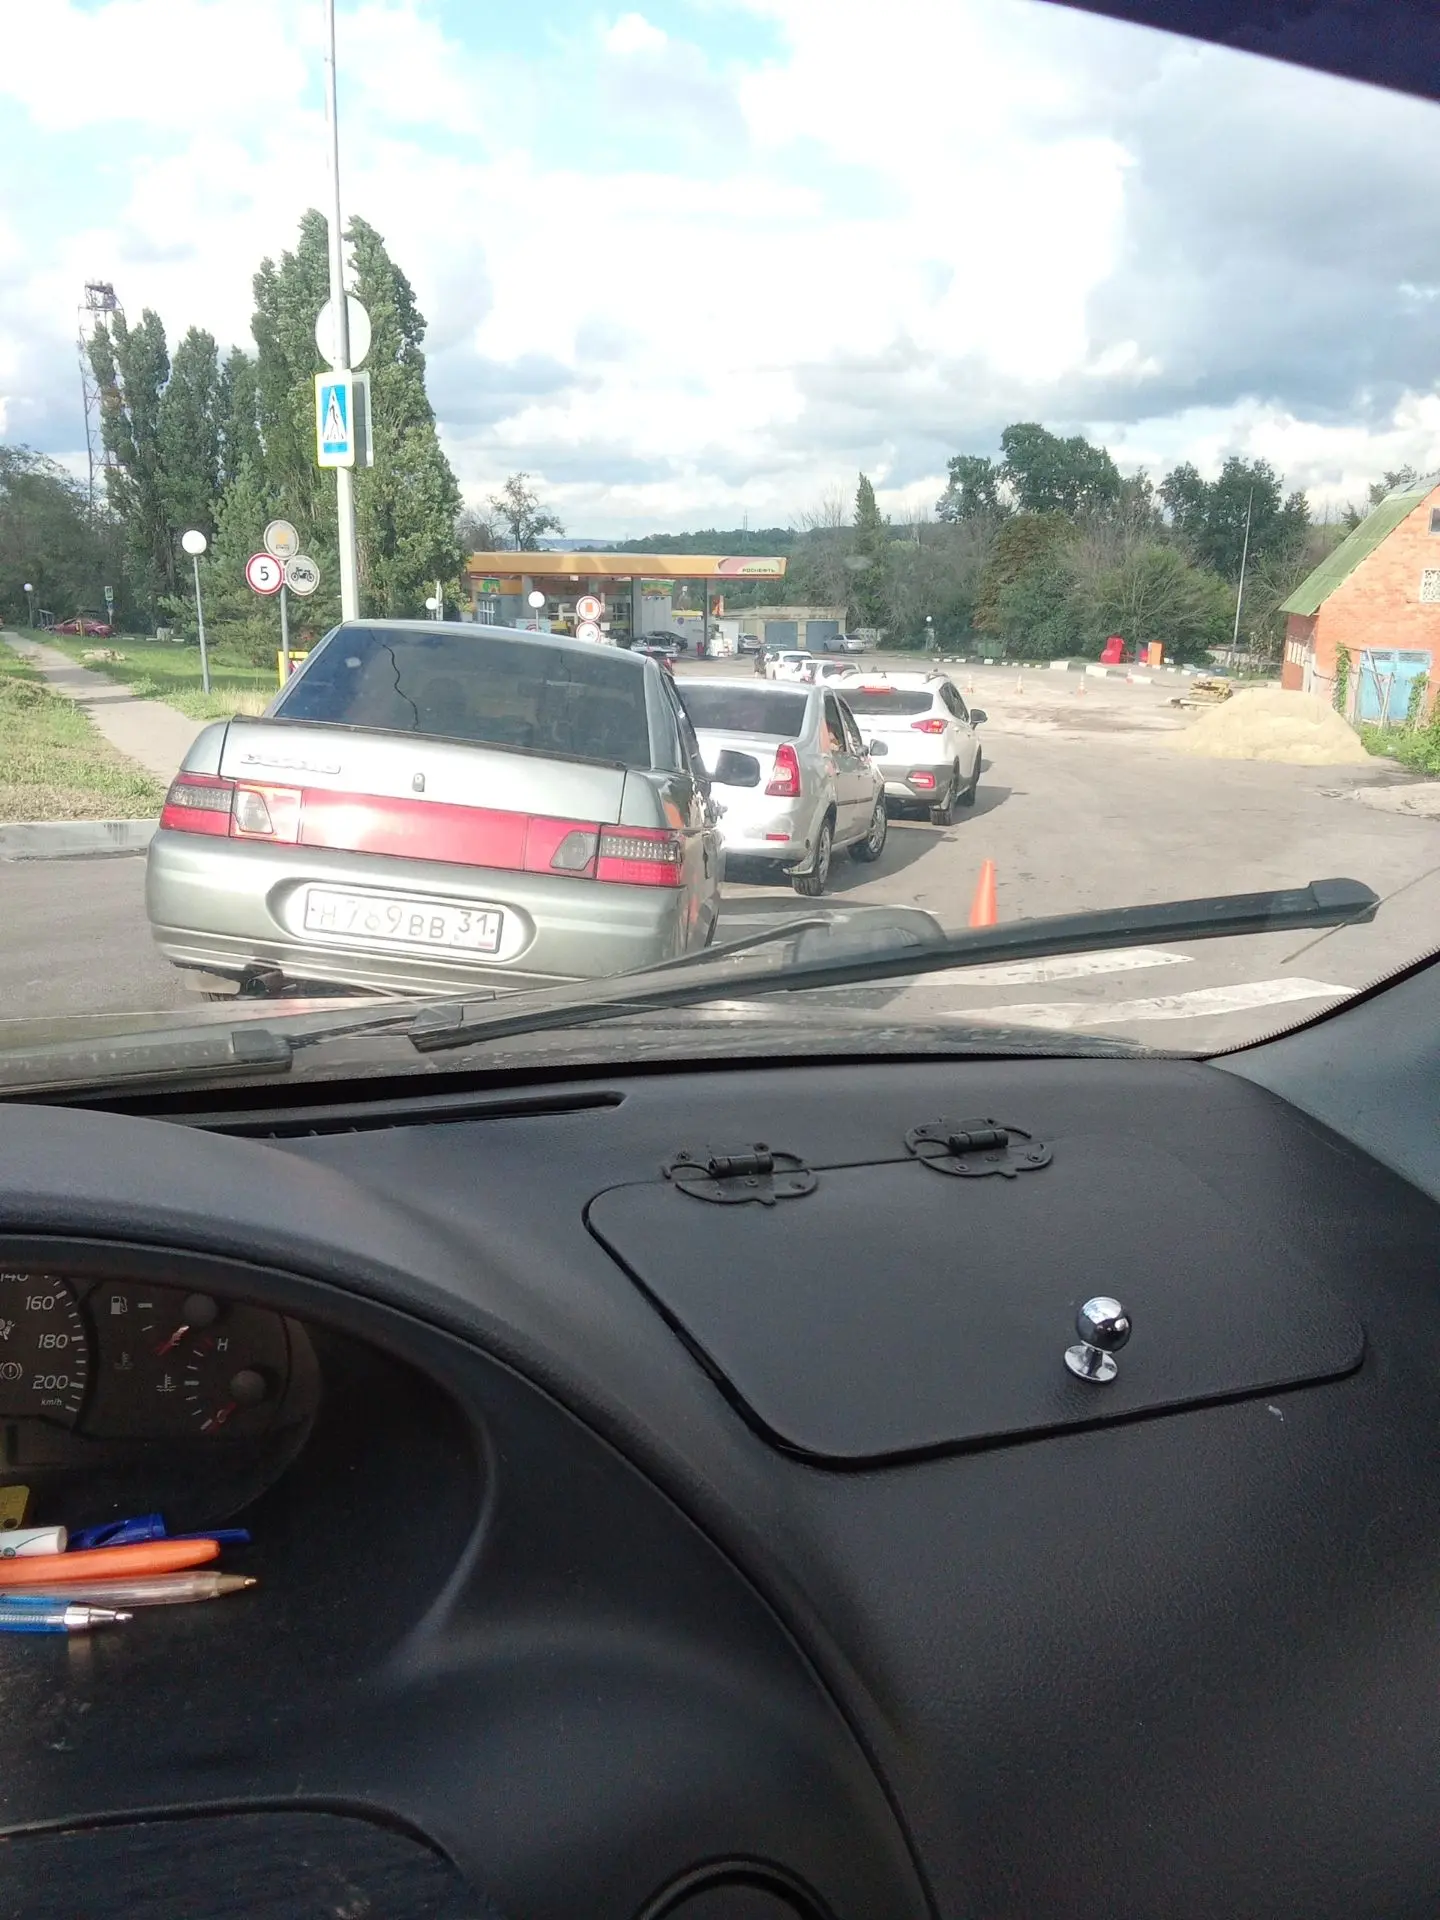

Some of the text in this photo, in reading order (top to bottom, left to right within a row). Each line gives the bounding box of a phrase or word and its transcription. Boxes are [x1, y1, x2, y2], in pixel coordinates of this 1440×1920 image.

[260, 565, 269, 581] 5
[26, 1295, 55, 1311] 160
[38, 1333, 69, 1349] 180
[217, 1338, 229, 1351] H
[32, 1375, 69, 1390] 200
[41, 1397, 63, 1406] km/h
